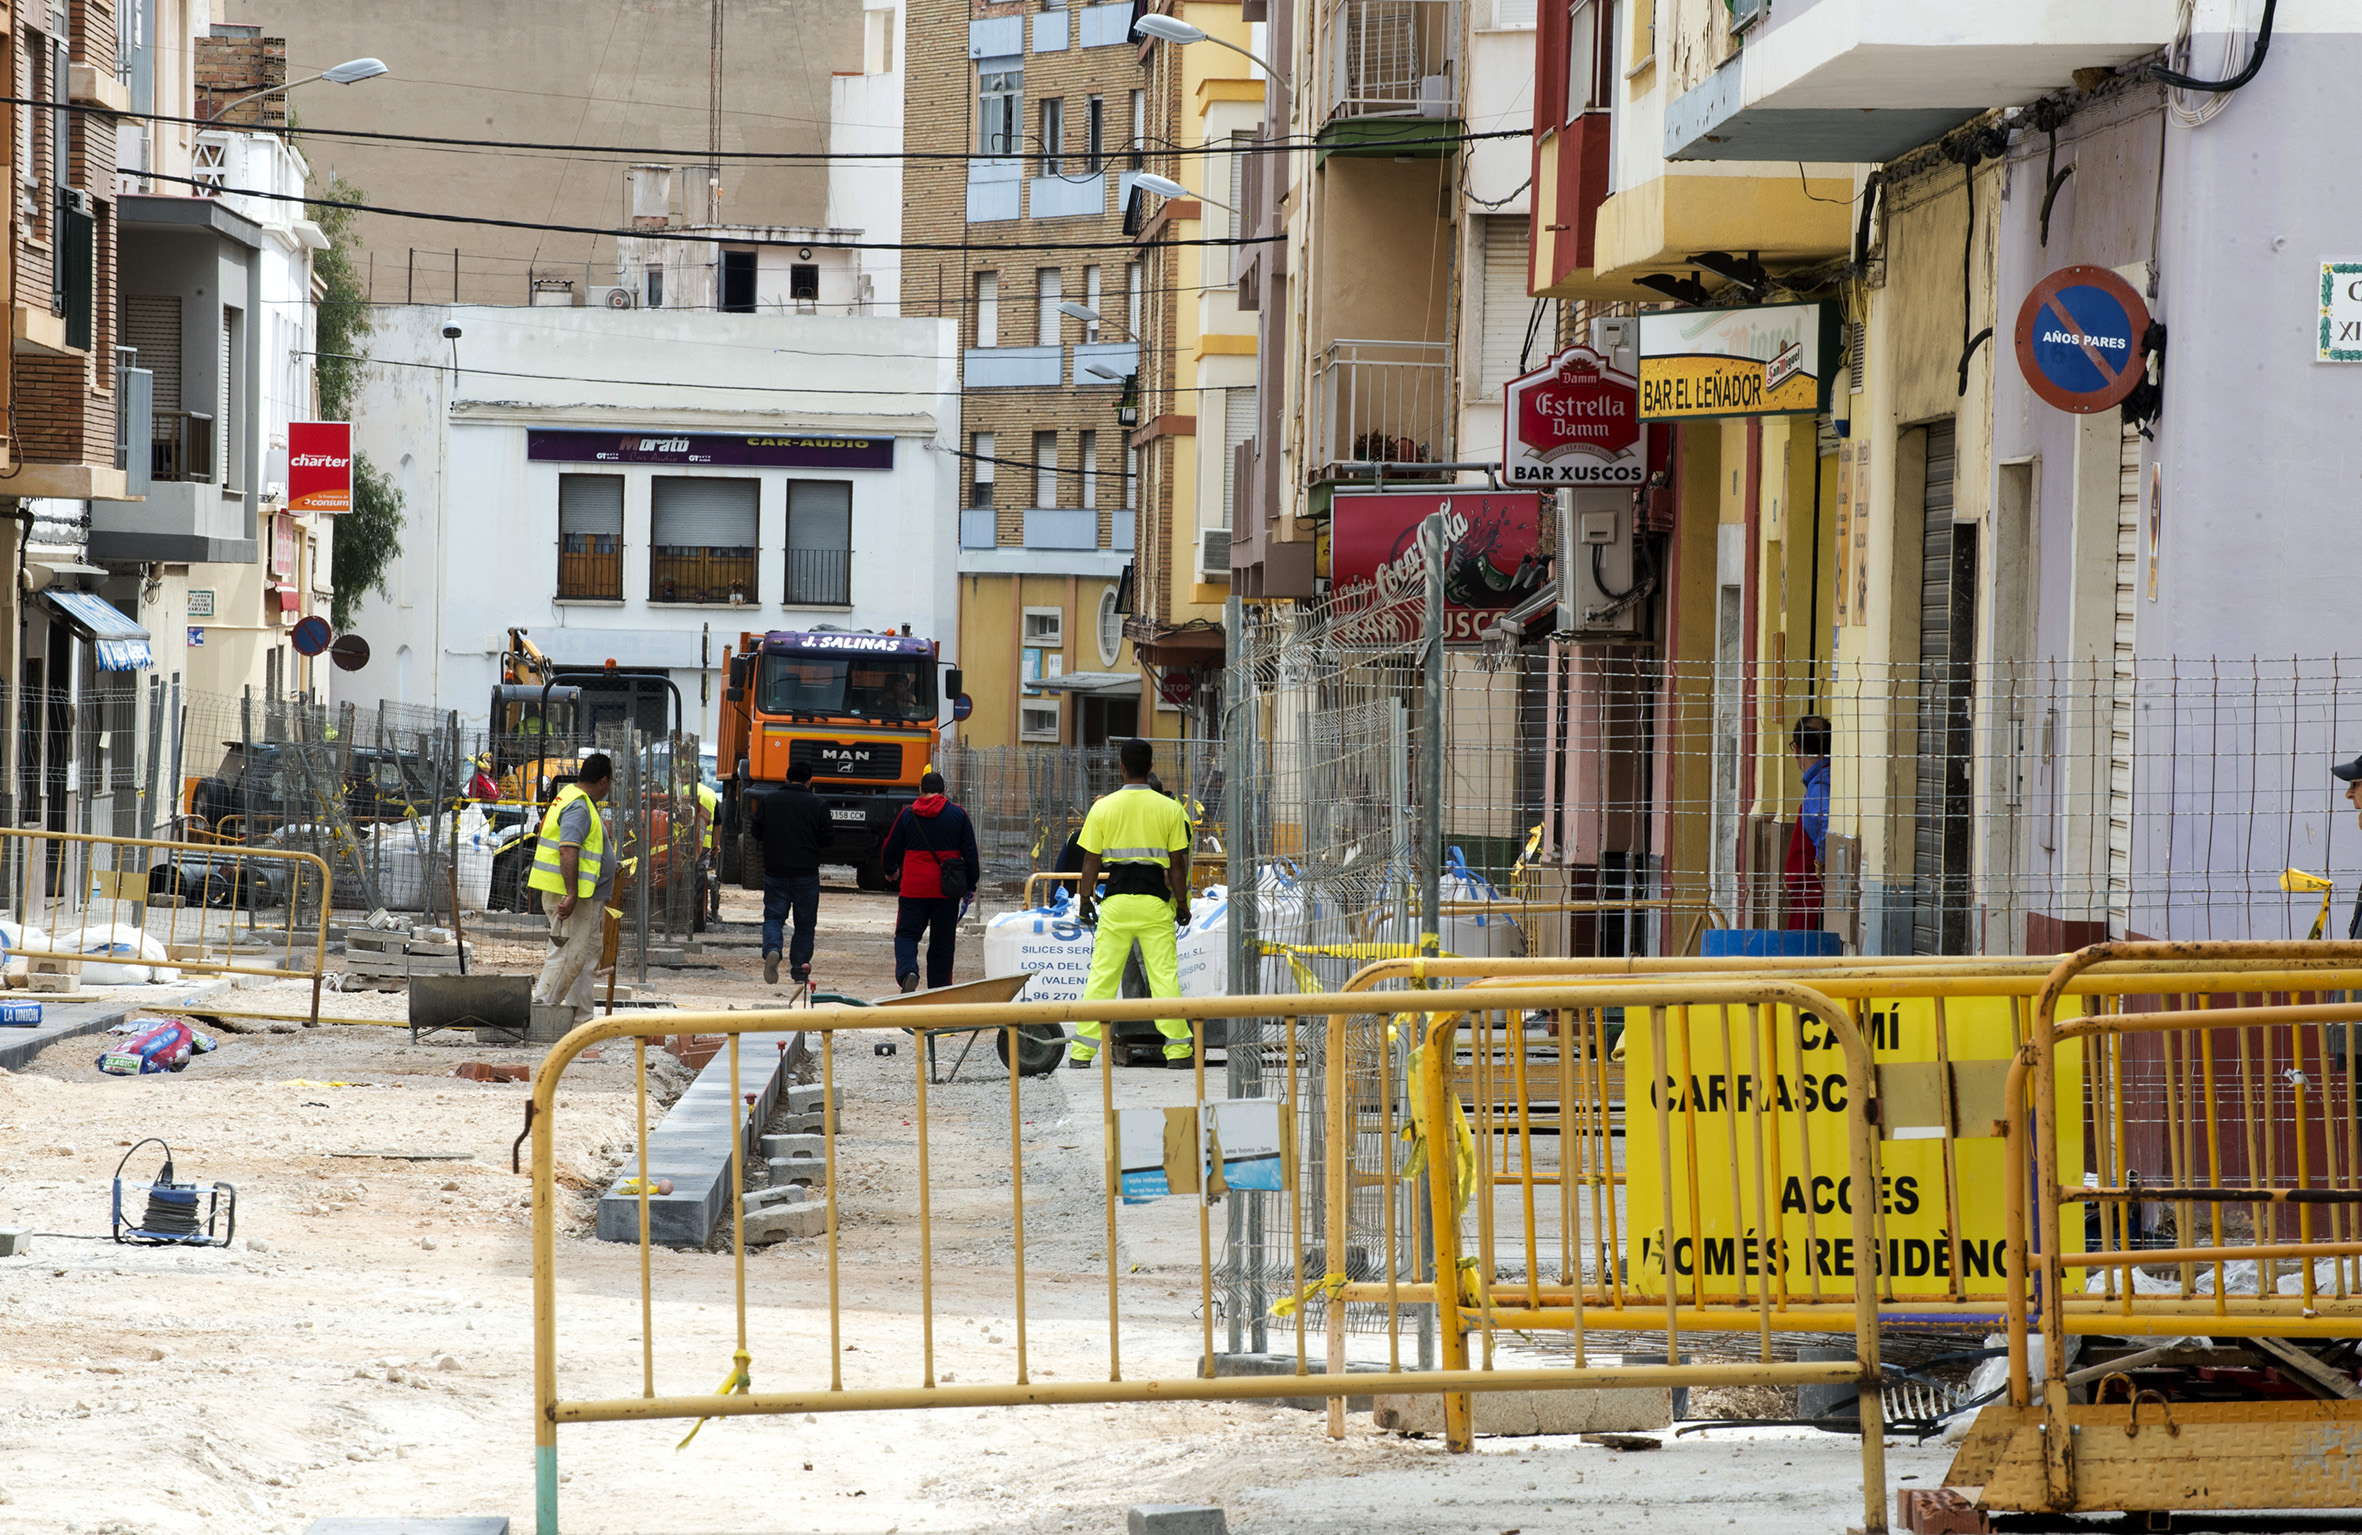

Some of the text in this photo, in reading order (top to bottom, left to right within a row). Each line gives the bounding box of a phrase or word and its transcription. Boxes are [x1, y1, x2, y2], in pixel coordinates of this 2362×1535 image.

[2043, 330, 2126, 349] AÑOS PARES
[1562, 372, 1598, 384] Damm
[1644, 369, 1762, 412] BAR EL LEÑADOR
[1535, 392, 1626, 417] Estrella
[1551, 418, 1610, 437] Damm
[619, 437, 690, 453] Morató
[747, 437, 870, 449] CAR-AUDIO
[290, 453, 349, 468] charter
[1514, 466, 1643, 481] BAR XUSCOS
[311, 499, 350, 507] consum
[801, 636, 900, 651] J. SALINAS
[1162, 684, 1191, 692] STOP
[822, 749, 870, 760] MAN
[1021, 945, 1064, 954] SILICES
[1020, 961, 1055, 971] LOSA
[1057, 962, 1083, 971] DEL
[1041, 976, 1088, 986] (VALEN
[1033, 991, 1077, 1001] 96 270
[4, 1008, 14, 1022] LA
[1651, 1074, 1849, 1113] CARRASC
